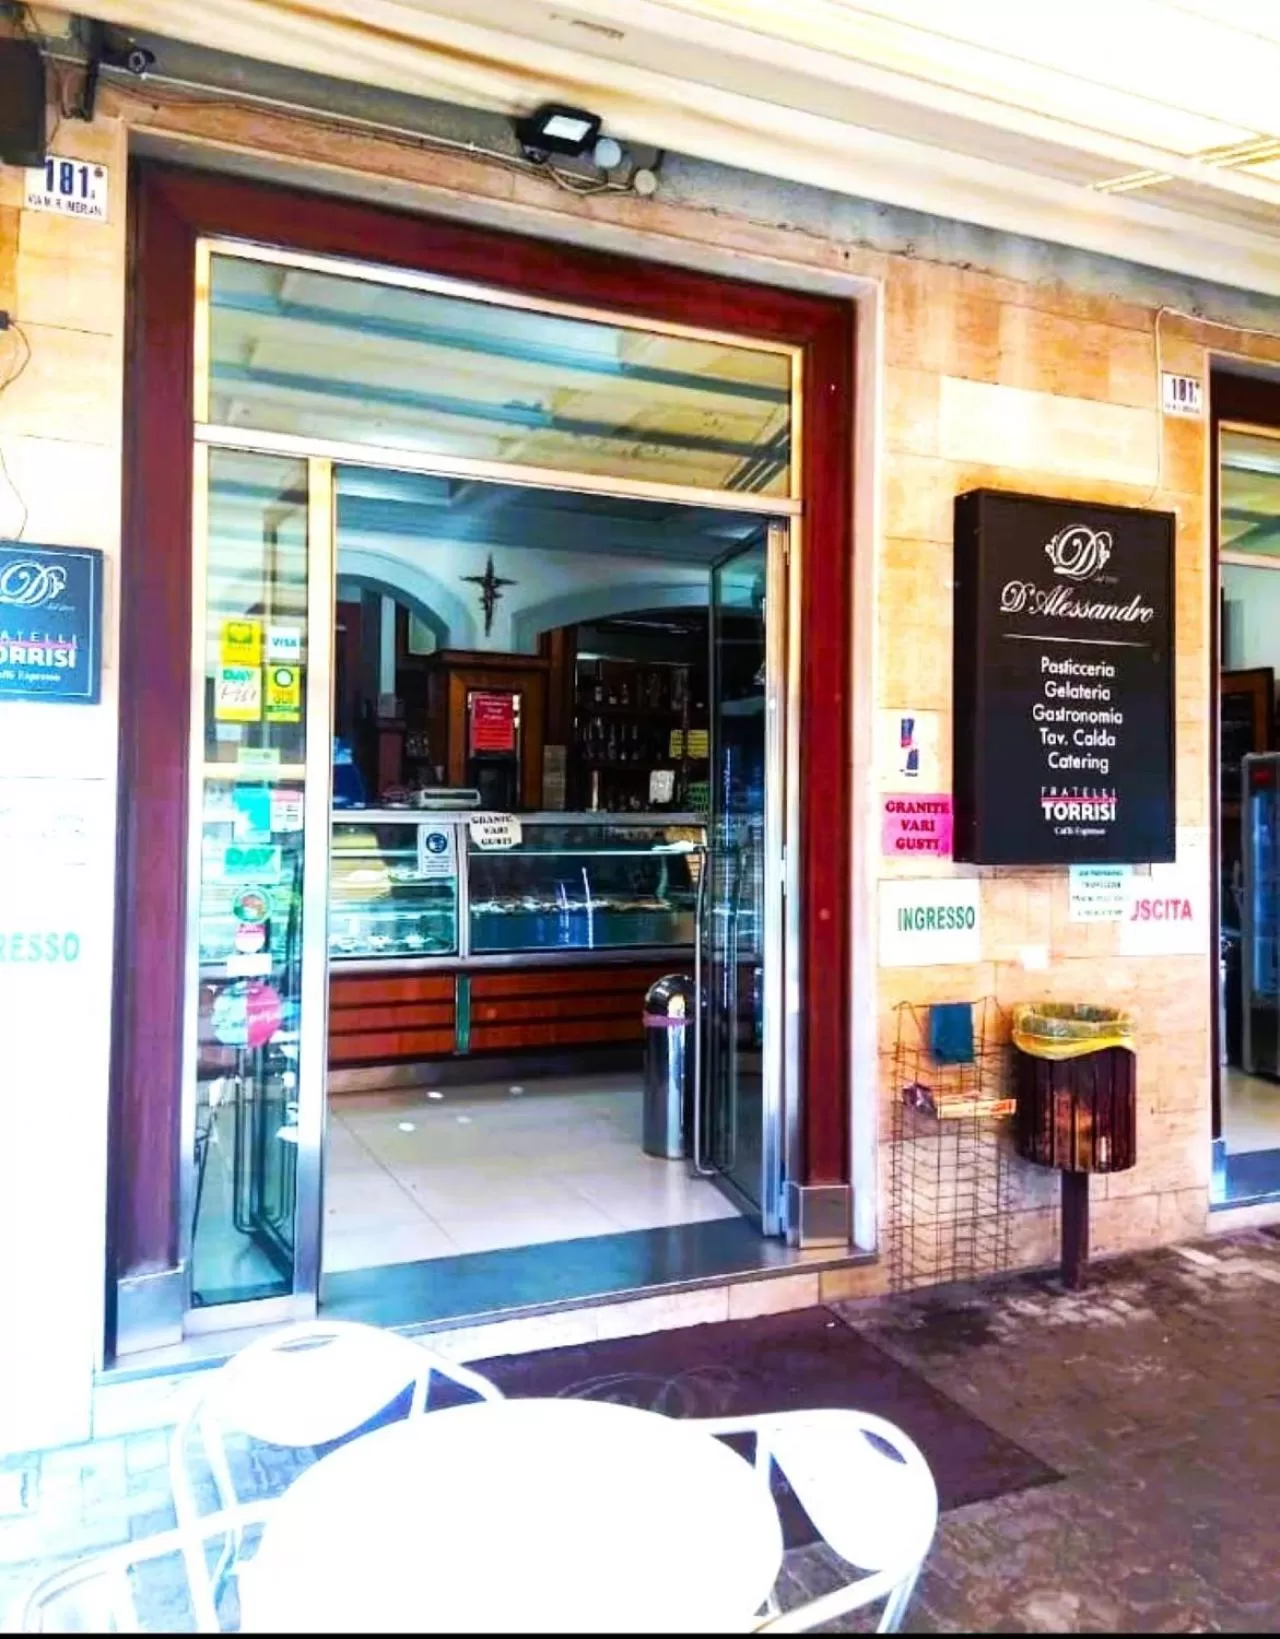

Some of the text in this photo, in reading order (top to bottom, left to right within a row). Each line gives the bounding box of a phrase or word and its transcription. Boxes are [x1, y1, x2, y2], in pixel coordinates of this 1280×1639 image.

[46, 159, 89, 198] 181
[1041, 656, 1115, 677] Pasticceria
[1045, 681, 1111, 701] Gelateria
[1033, 704, 1123, 724] Gastronomia
[1040, 728, 1116, 746] Tav. Calda
[1048, 752, 1109, 774] Catering
[885, 801, 949, 815] GRANITE
[1041, 802, 1116, 821] TORRISI
[901, 820, 935, 832] VARI
[896, 838, 940, 850] GUSTI
[897, 907, 976, 932] INGRESSO
